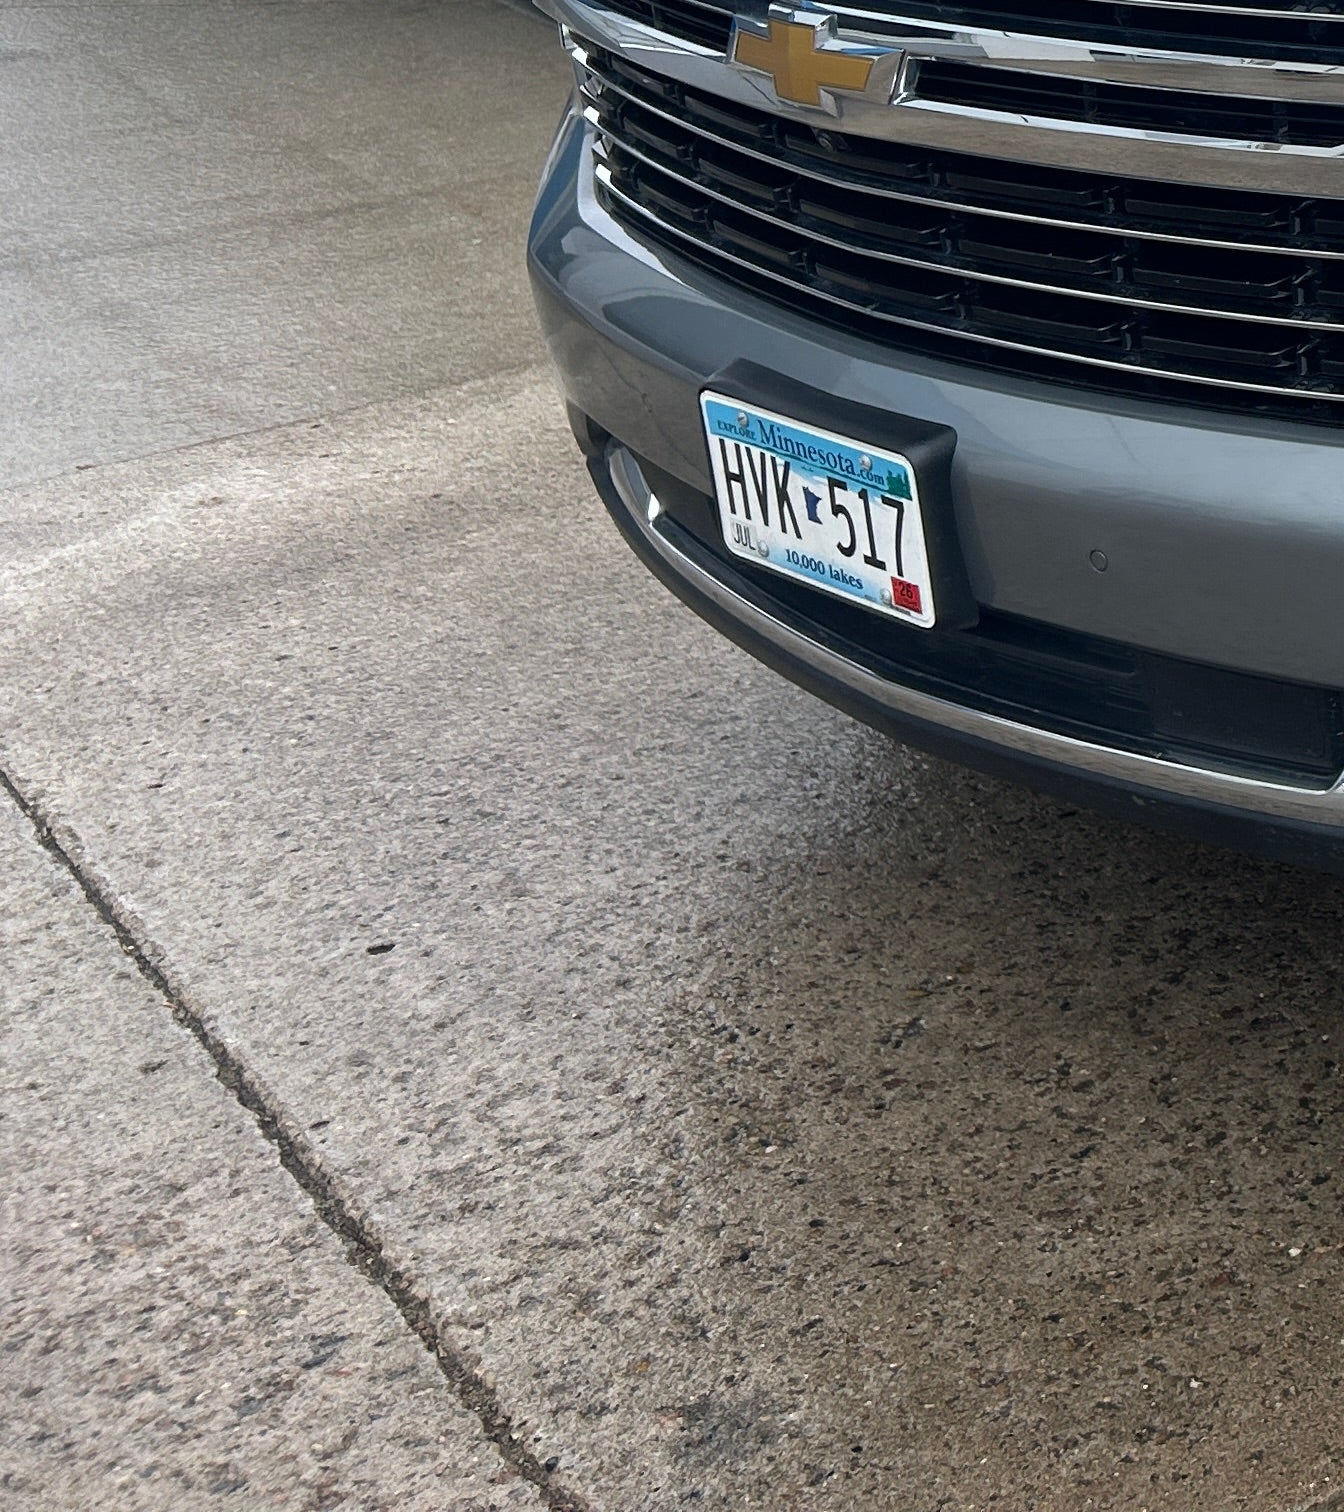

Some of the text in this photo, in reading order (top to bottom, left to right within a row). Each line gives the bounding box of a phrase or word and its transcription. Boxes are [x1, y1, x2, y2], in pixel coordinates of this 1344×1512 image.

[719, 438, 906, 577] HVK 517
[733, 522, 757, 552] JUL
[785, 548, 863, 590] 10,000 lakes
[898, 581, 914, 600] 26
